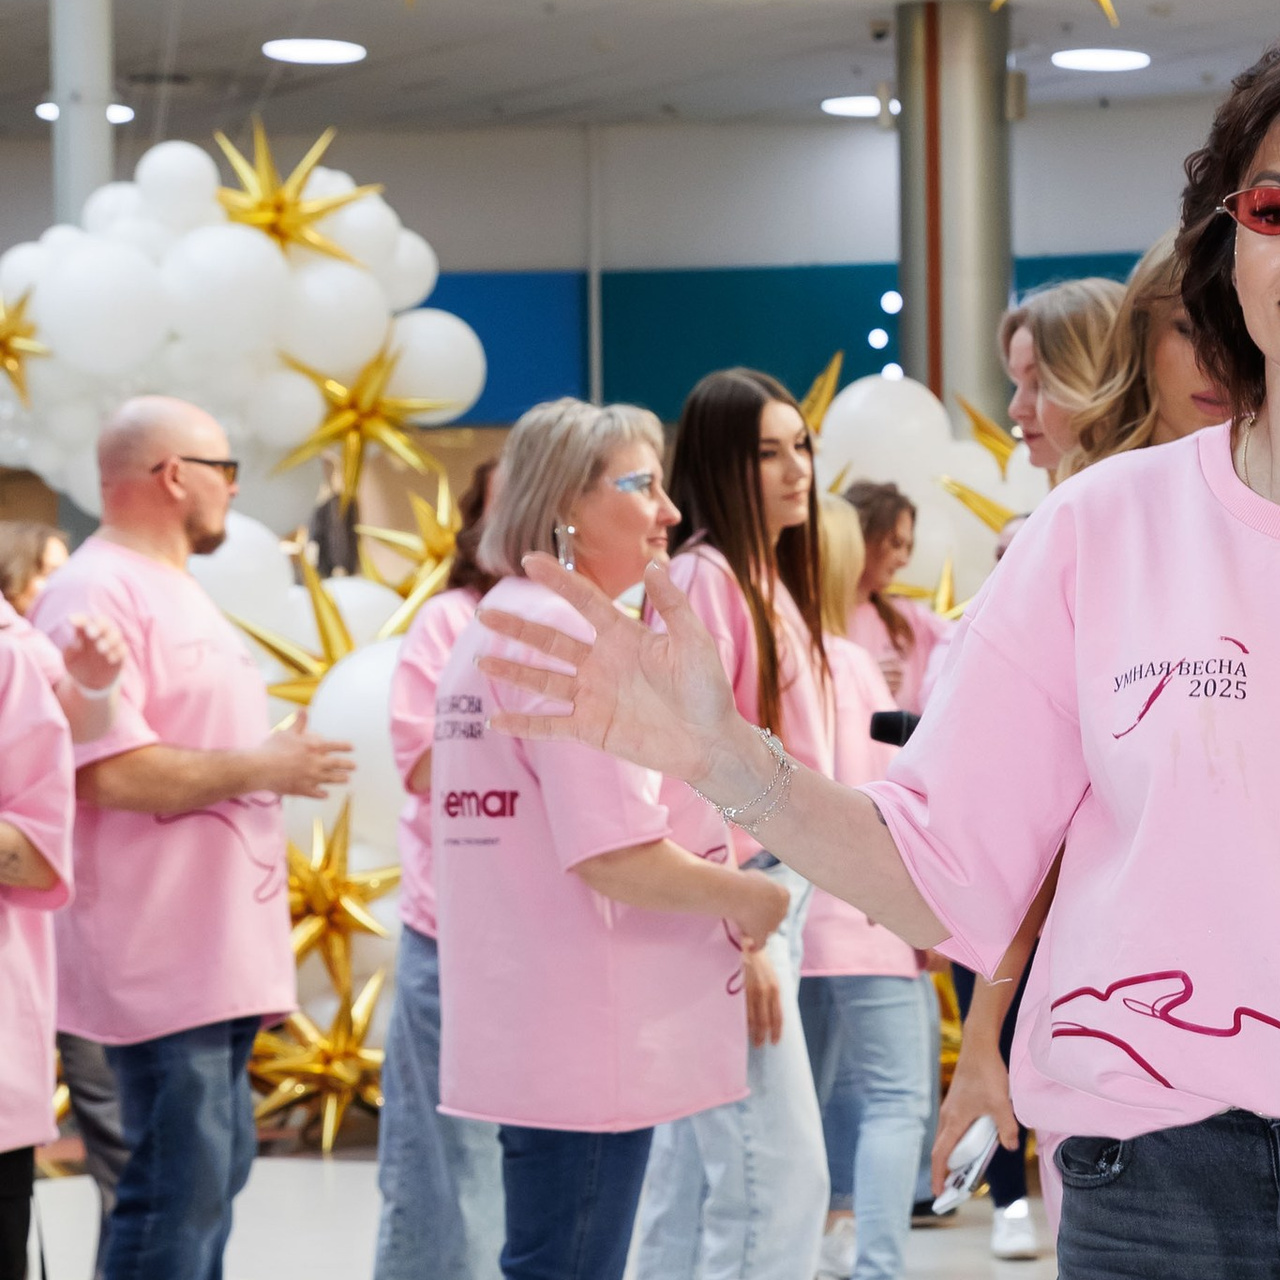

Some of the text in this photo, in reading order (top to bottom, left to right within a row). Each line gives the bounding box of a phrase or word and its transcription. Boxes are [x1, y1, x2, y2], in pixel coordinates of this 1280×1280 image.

[1114, 658, 1248, 693] УМНАЯ ВЕСНА
[1188, 677, 1248, 701] 2025
